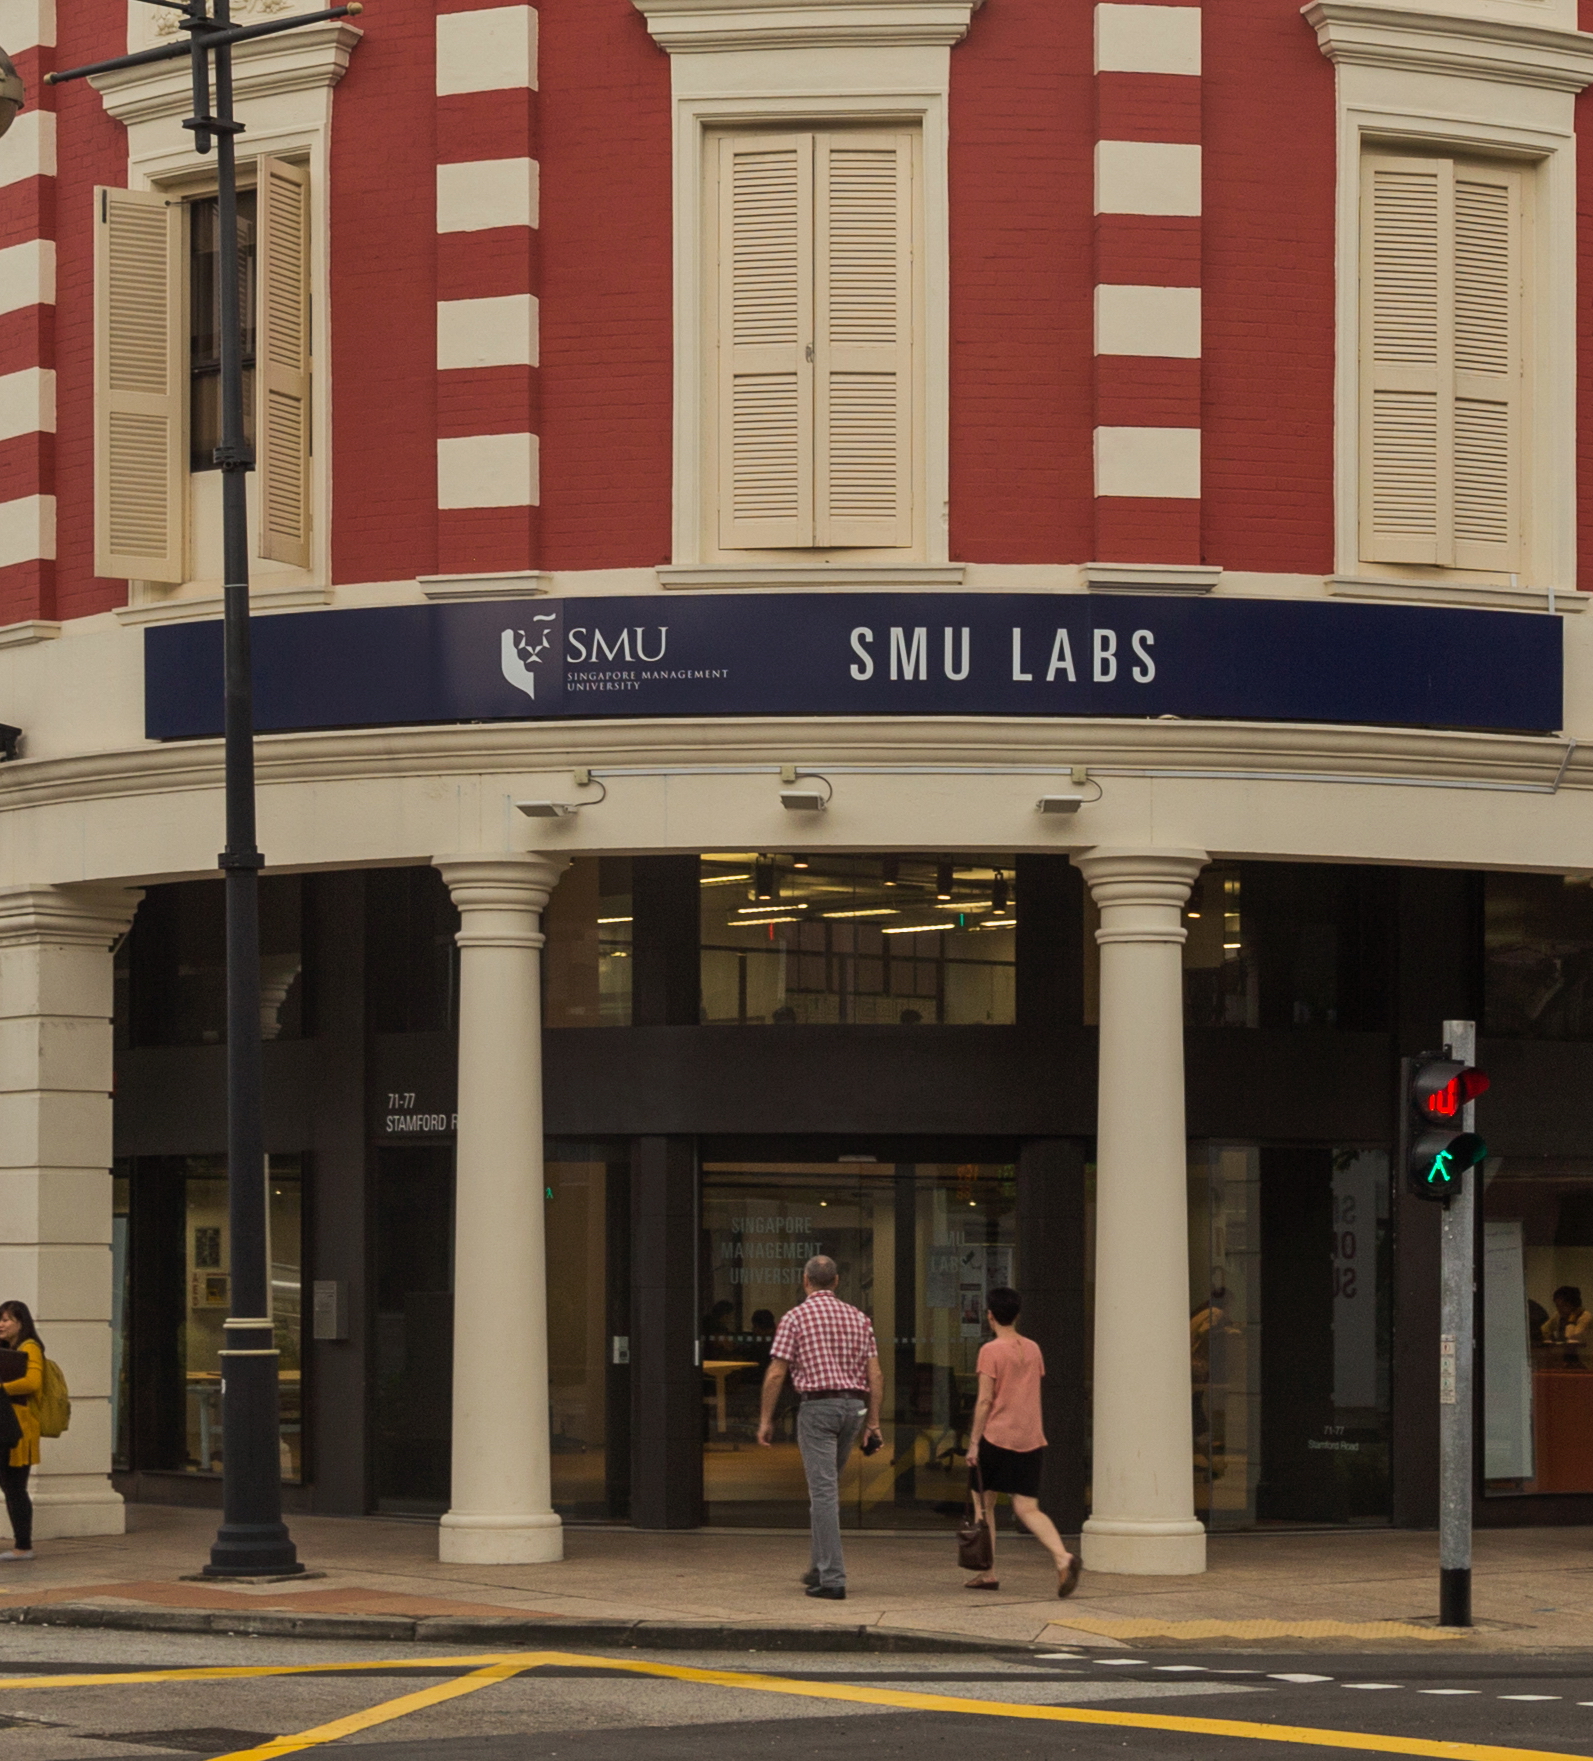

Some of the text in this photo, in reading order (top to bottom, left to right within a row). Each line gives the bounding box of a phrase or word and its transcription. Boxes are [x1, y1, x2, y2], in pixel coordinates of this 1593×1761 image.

[567, 626, 669, 664] SMU
[850, 626, 1156, 684] SMU LABS
[567, 668, 729, 681] SINGAPORE MANAGEMENT
[567, 681, 642, 692] UNIVERSITY
[388, 1093, 416, 1109] 71-77
[386, 1114, 447, 1132] STAMFORD
[731, 1216, 812, 1234] SINGAPORE
[721, 1242, 823, 1259] MANAGEMENT
[729, 1267, 804, 1285] UNIVERSIT
[1307, 1439, 1360, 1451] Stamford Road
